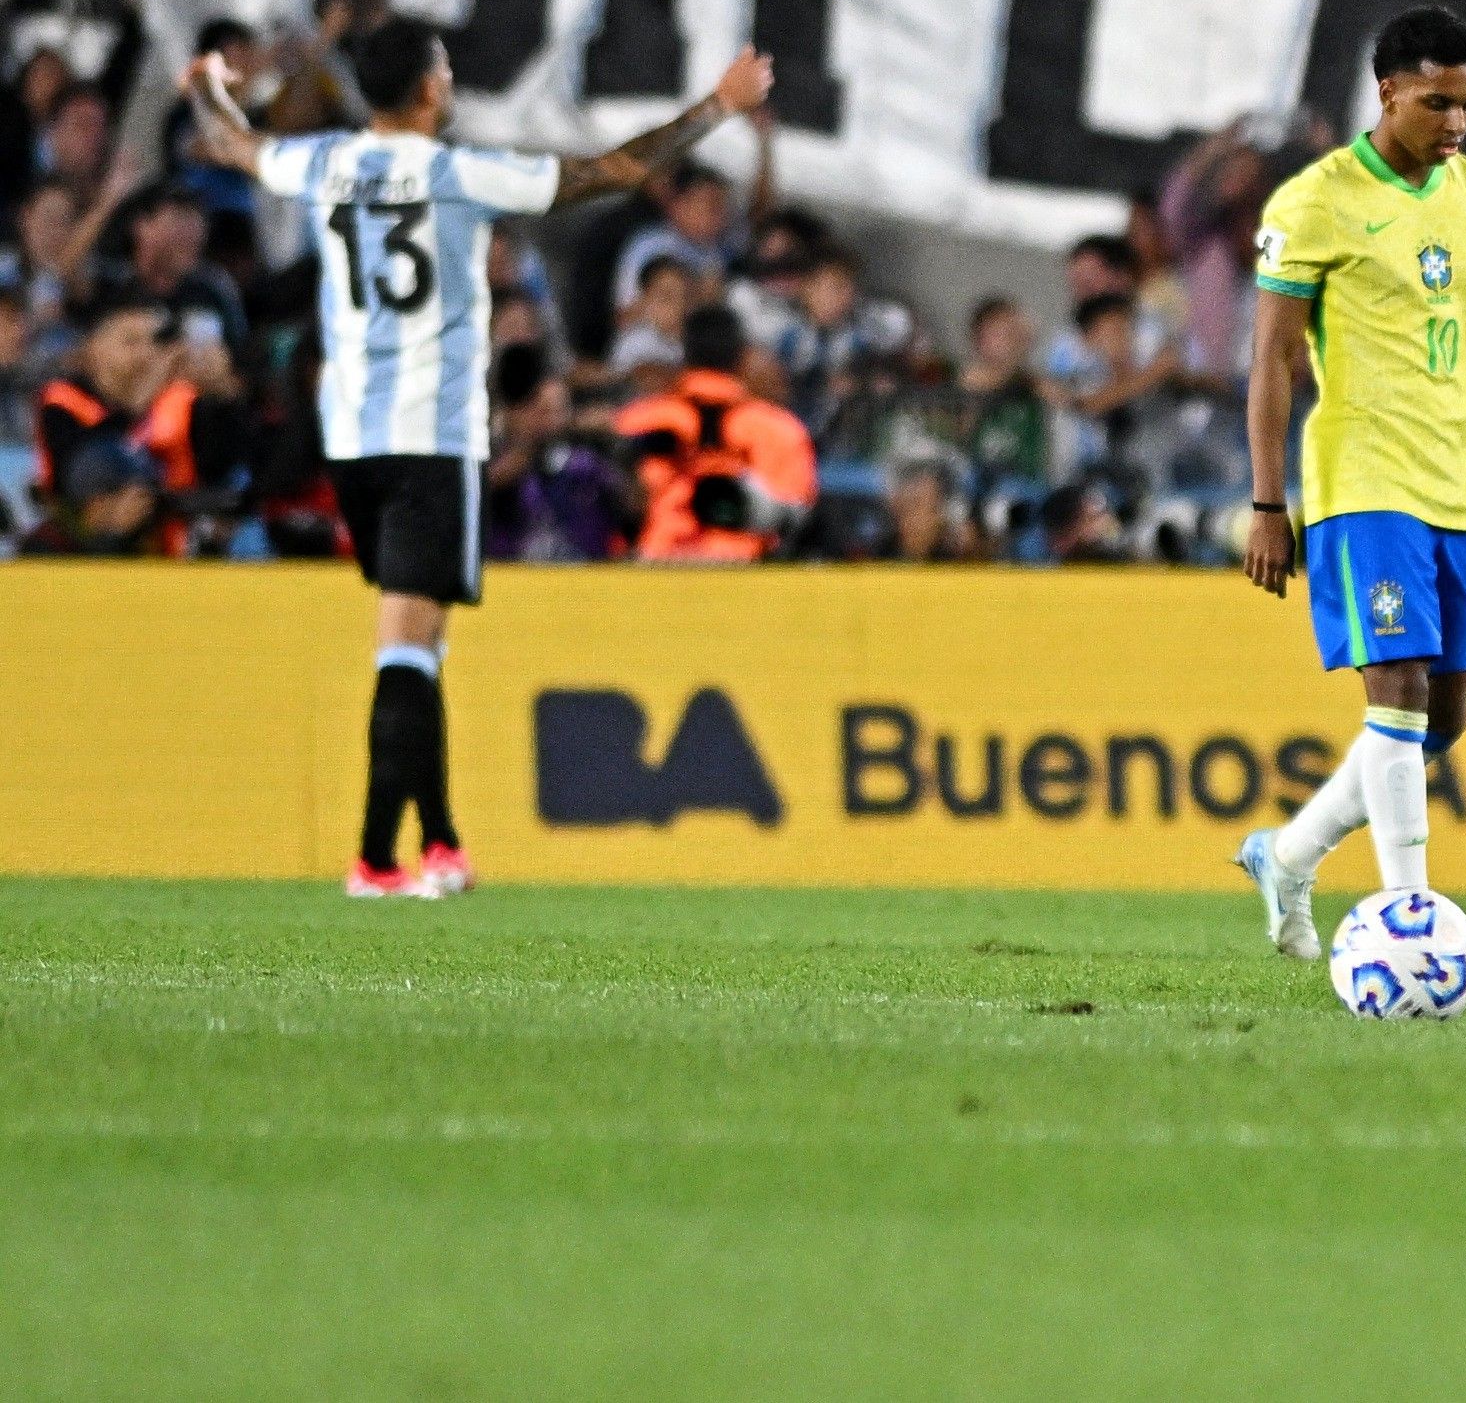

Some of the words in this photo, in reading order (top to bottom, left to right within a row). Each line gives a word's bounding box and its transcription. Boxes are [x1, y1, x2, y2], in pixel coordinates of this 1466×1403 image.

[328, 200, 435, 314] 13
[1427, 316, 1459, 373] 10
[534, 686, 784, 827] BA
[840, 702, 1338, 820] Buenos
